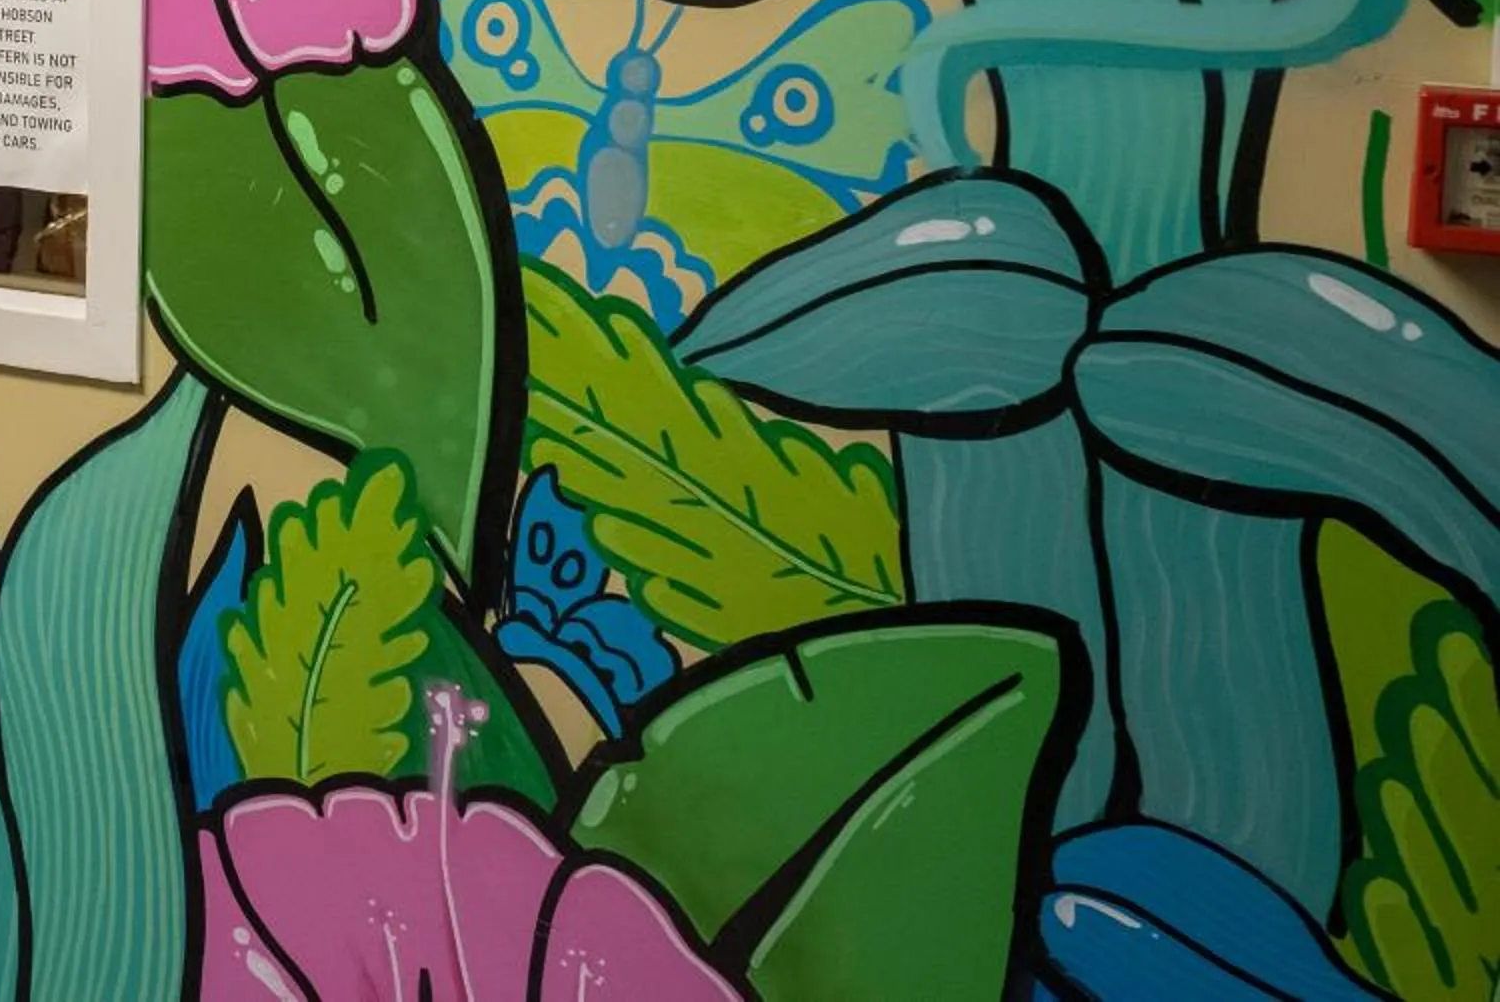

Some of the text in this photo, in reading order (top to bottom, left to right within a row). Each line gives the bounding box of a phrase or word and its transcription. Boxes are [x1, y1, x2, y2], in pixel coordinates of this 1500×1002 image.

[1, 7, 53, 23] HOBSON
[33, 53, 45, 66] IS
[49, 53, 77, 68] NOT
[45, 75, 73, 89] FOR
[21, 115, 73, 133] TOWING
